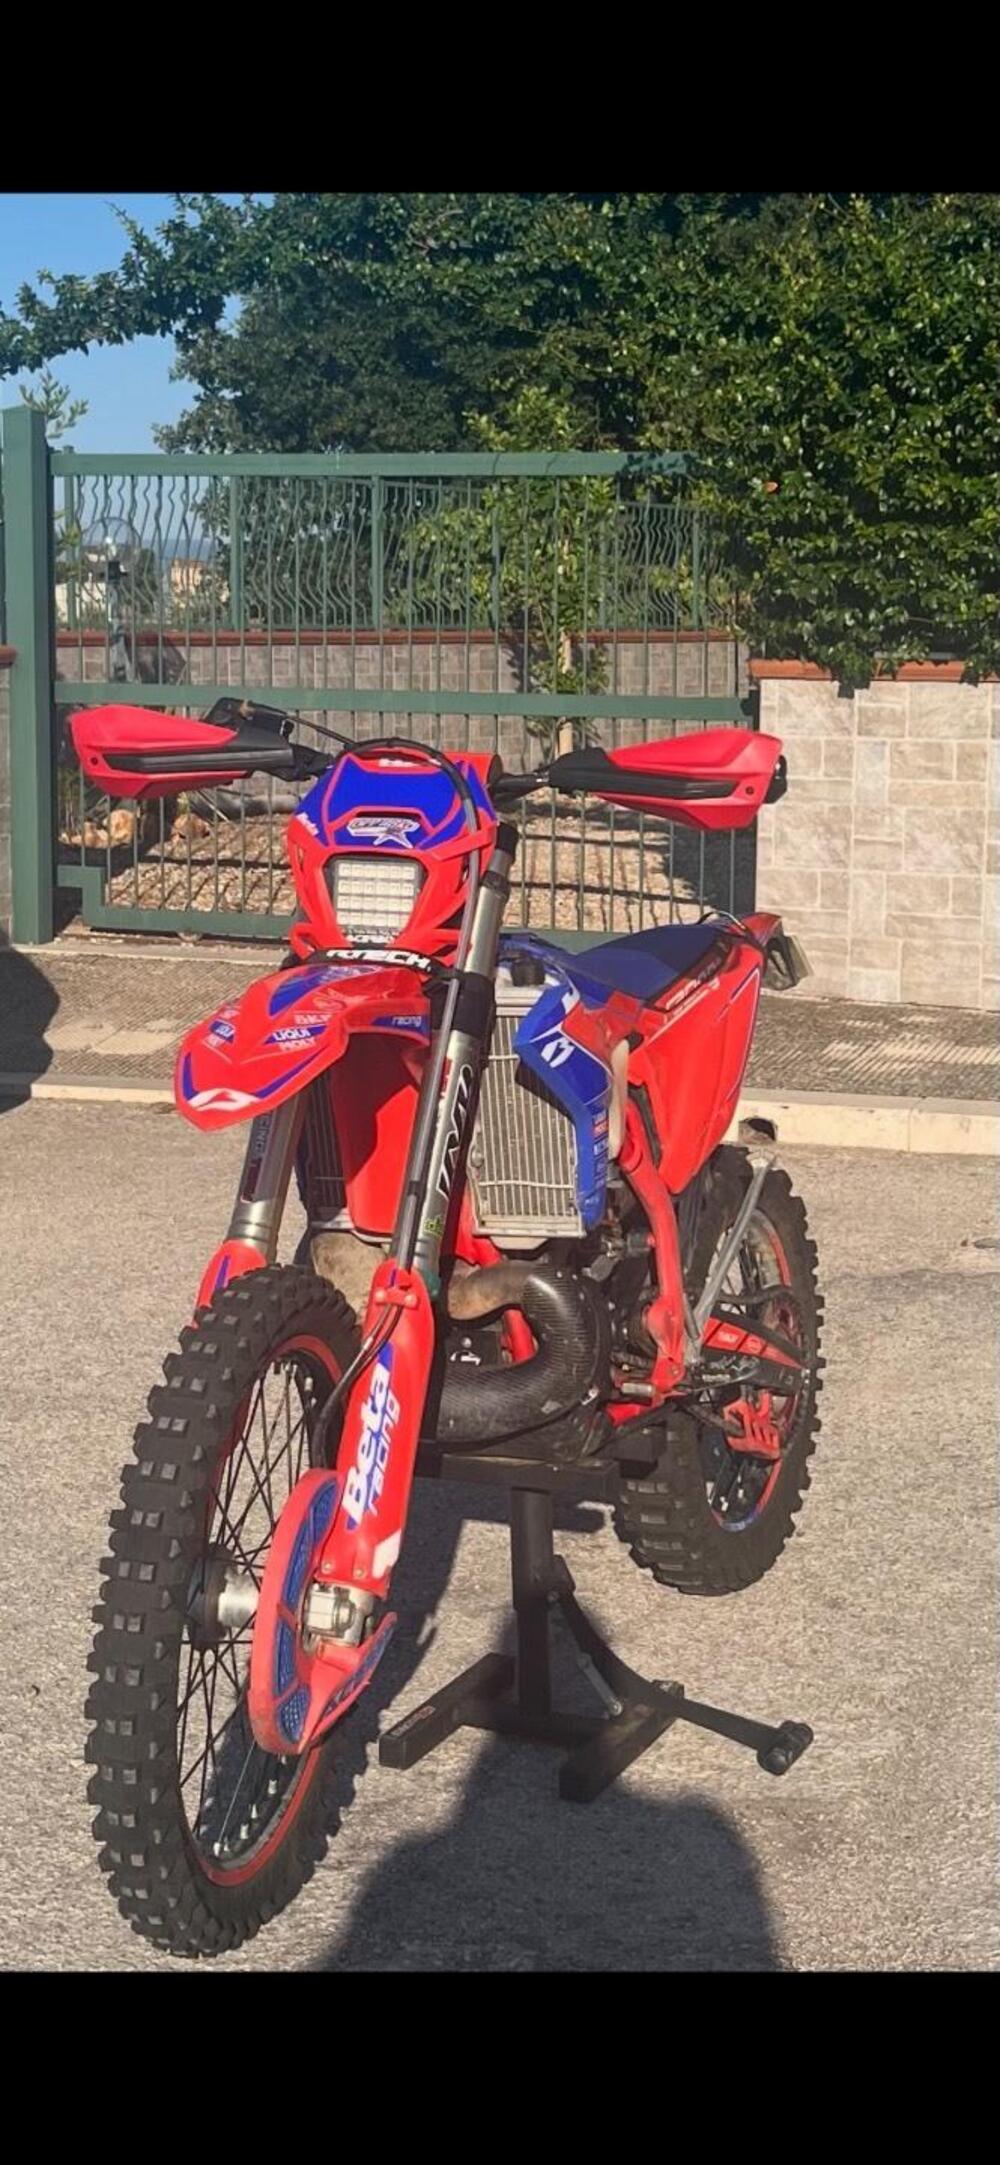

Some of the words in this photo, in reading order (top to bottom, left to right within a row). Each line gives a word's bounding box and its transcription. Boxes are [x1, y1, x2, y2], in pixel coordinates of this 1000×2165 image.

[272, 1027, 312, 1041] LIQUI
[391, 1015, 422, 1028] racing
[341, 1362, 390, 1525] Beta
[367, 1389, 400, 1516] racing
